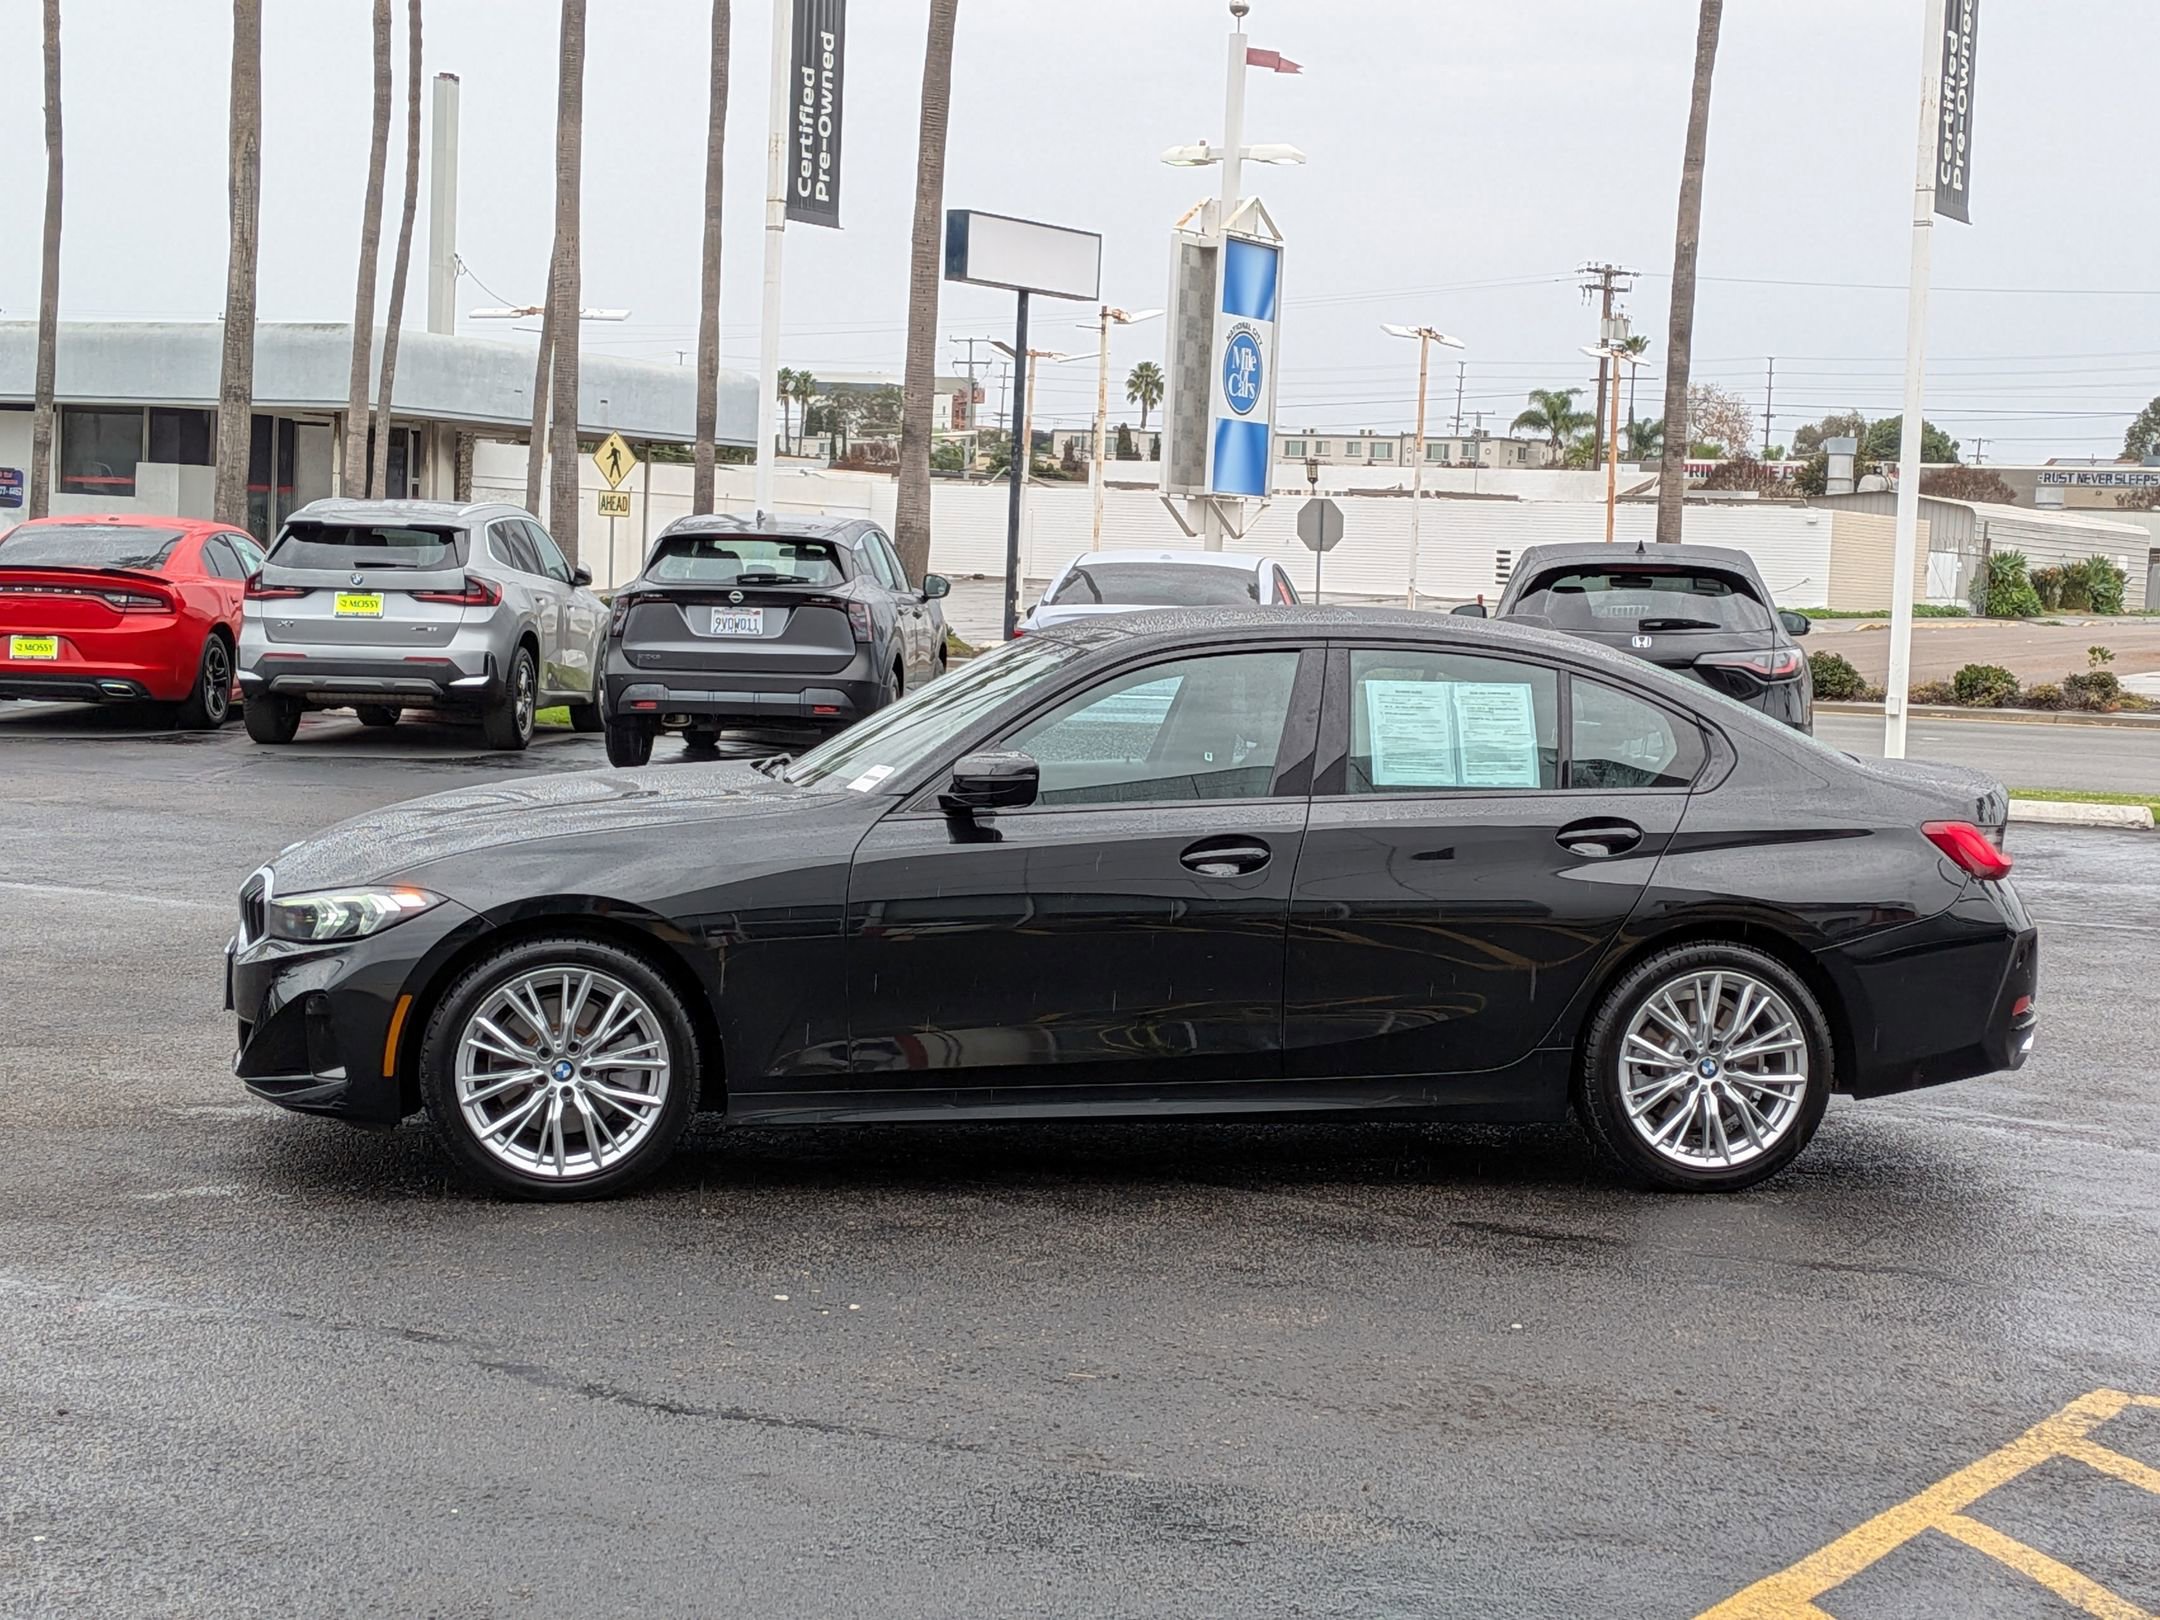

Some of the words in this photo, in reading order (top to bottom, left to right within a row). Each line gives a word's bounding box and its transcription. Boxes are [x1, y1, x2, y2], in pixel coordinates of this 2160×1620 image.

[815, 30, 835, 202] Pre-Owned
[1940, 30, 1958, 185] Certified
[797, 65, 816, 198] Certified
[1226, 321, 1252, 341] NATIONAL
[1231, 345, 1257, 371] Mile
[1228, 373, 1256, 400] Cars
[2076, 473, 2113, 484] NEVER
[2114, 474, 2159, 486] SLEEPS
[600, 495, 628, 512] AHEAD
[350, 600, 379, 608] MOSSY
[25, 643, 53, 652] MOSSY
